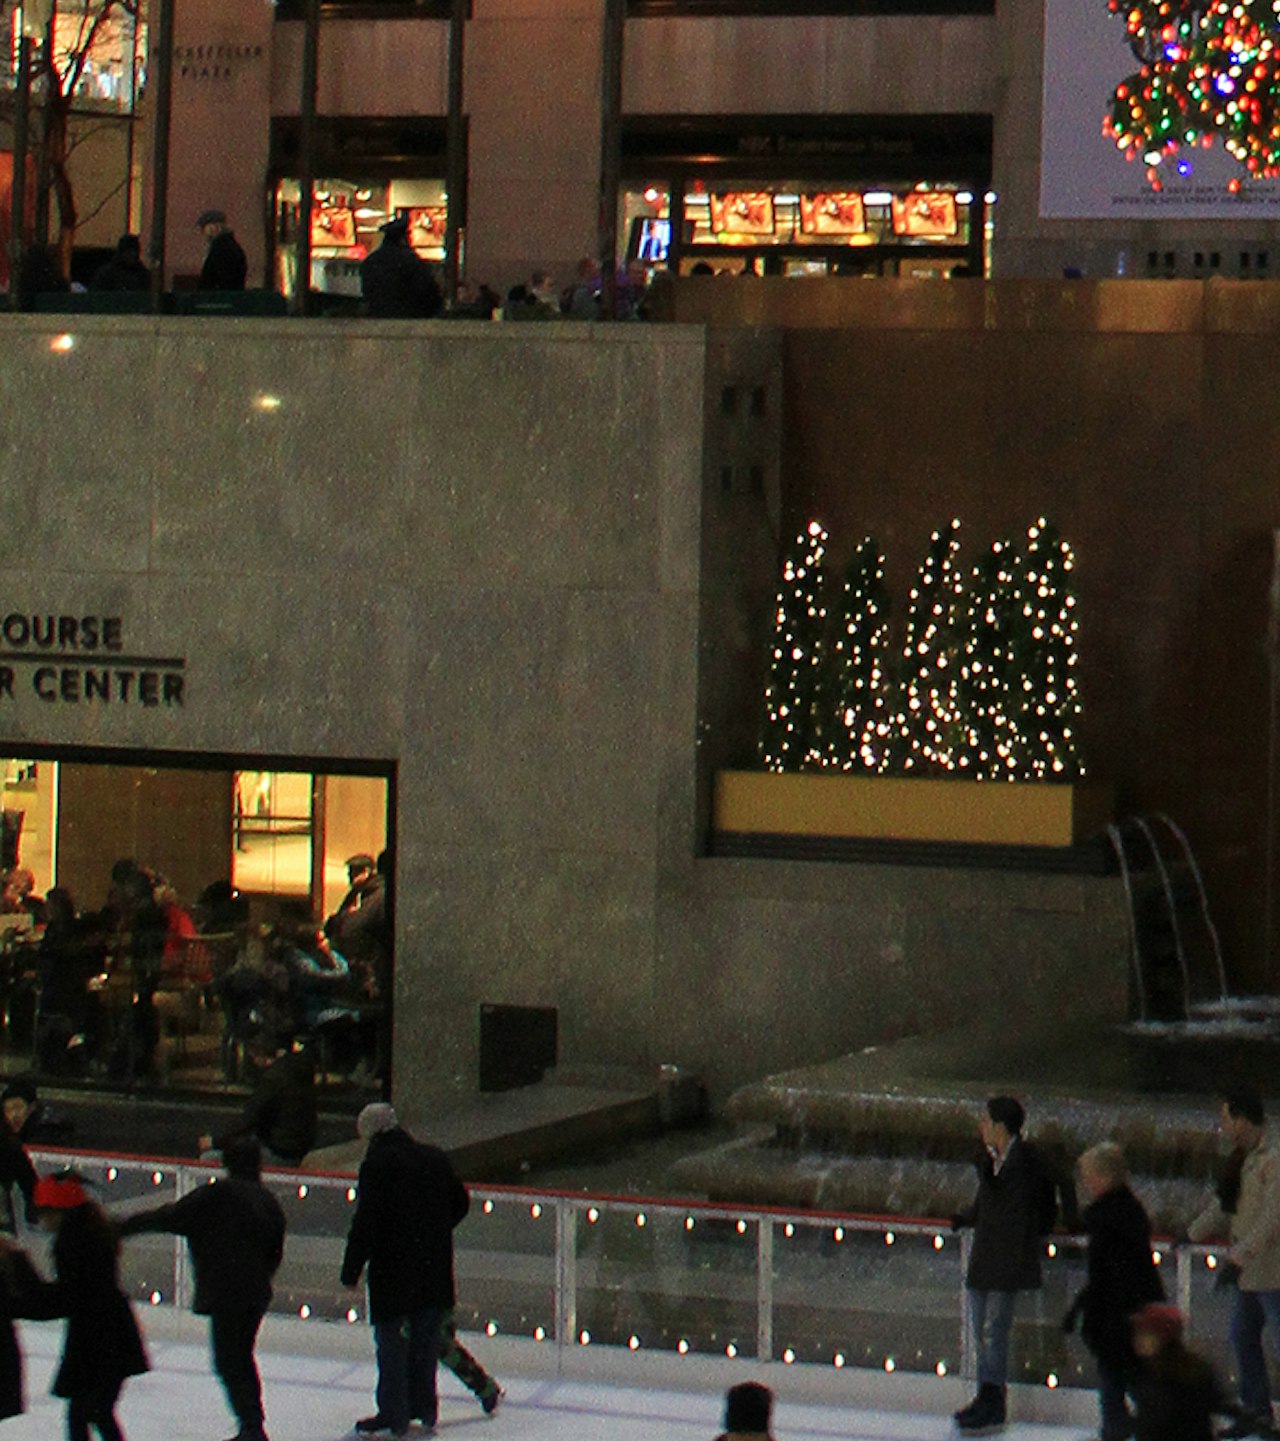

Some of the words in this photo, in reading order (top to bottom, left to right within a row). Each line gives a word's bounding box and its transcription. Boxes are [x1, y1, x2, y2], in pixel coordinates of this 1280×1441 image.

[152, 45, 262, 60] RCKEFELLER
[0, 613, 123, 652] OURSE
[33, 665, 185, 708] CENTER
